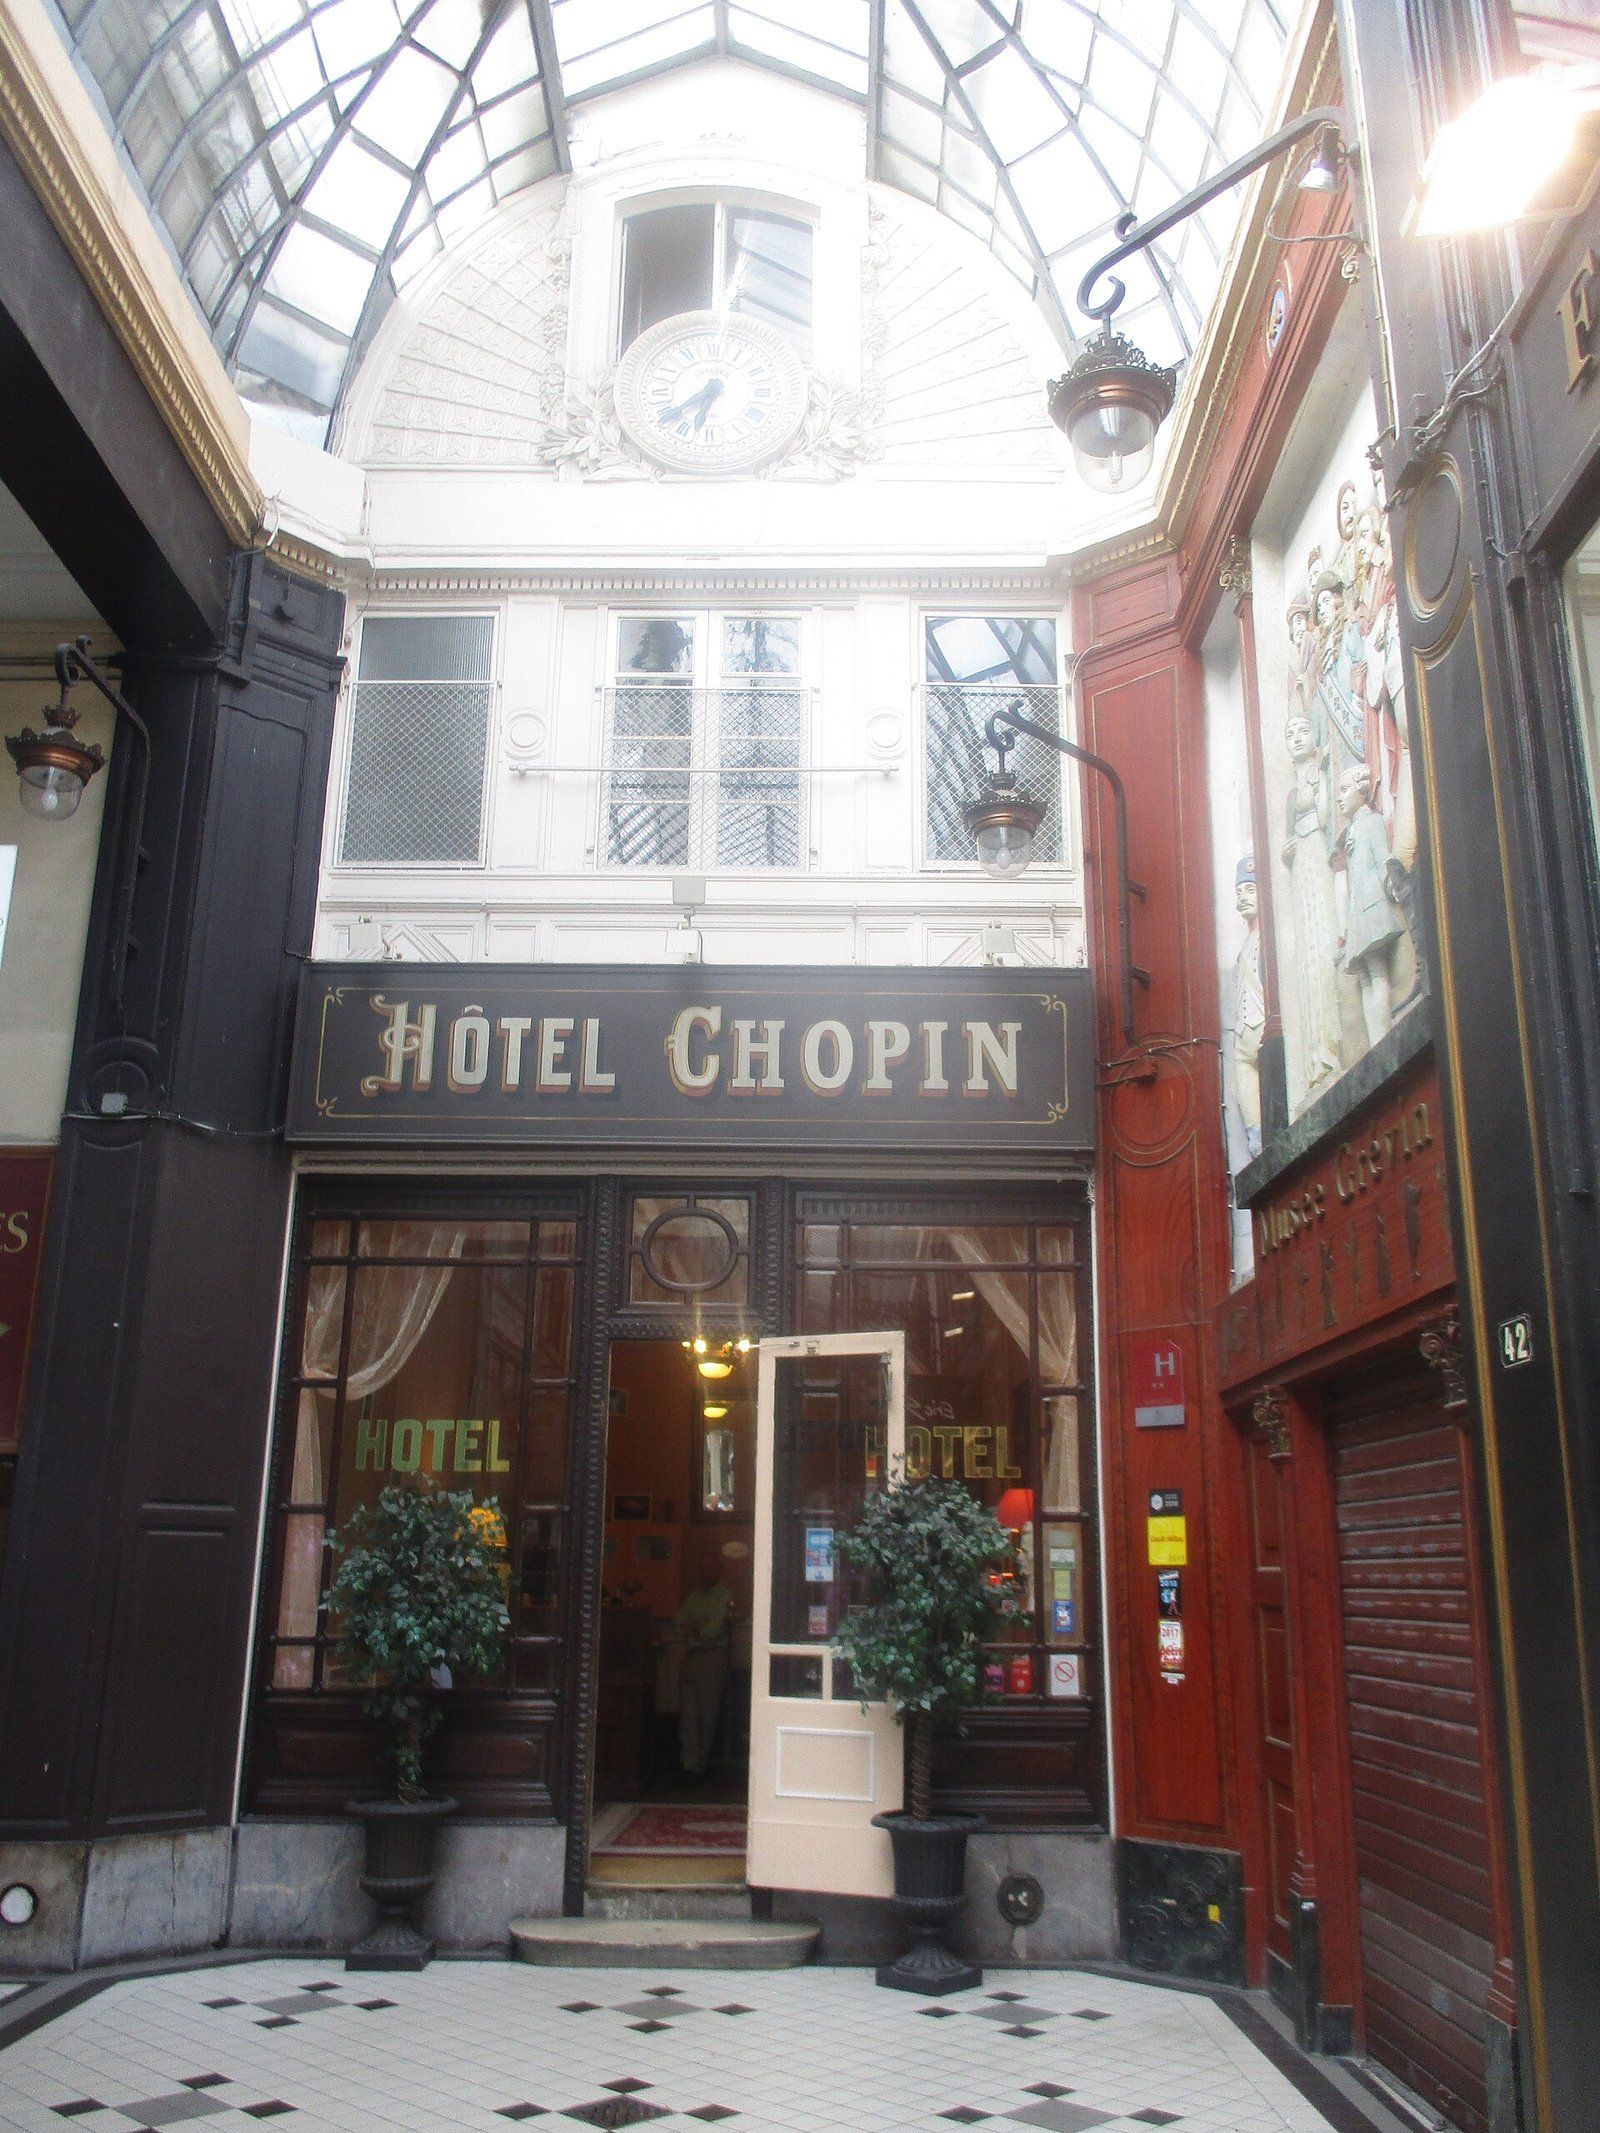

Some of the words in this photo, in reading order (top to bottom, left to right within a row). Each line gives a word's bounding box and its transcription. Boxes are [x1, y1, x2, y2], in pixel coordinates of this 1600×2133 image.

[361, 993, 617, 1095] HÔTEL
[664, 1005, 1023, 1097] CHOPIN
[1154, 1351, 1176, 1378] H
[1504, 1321, 1529, 1362] 42
[355, 1418, 510, 1473] HOTEL
